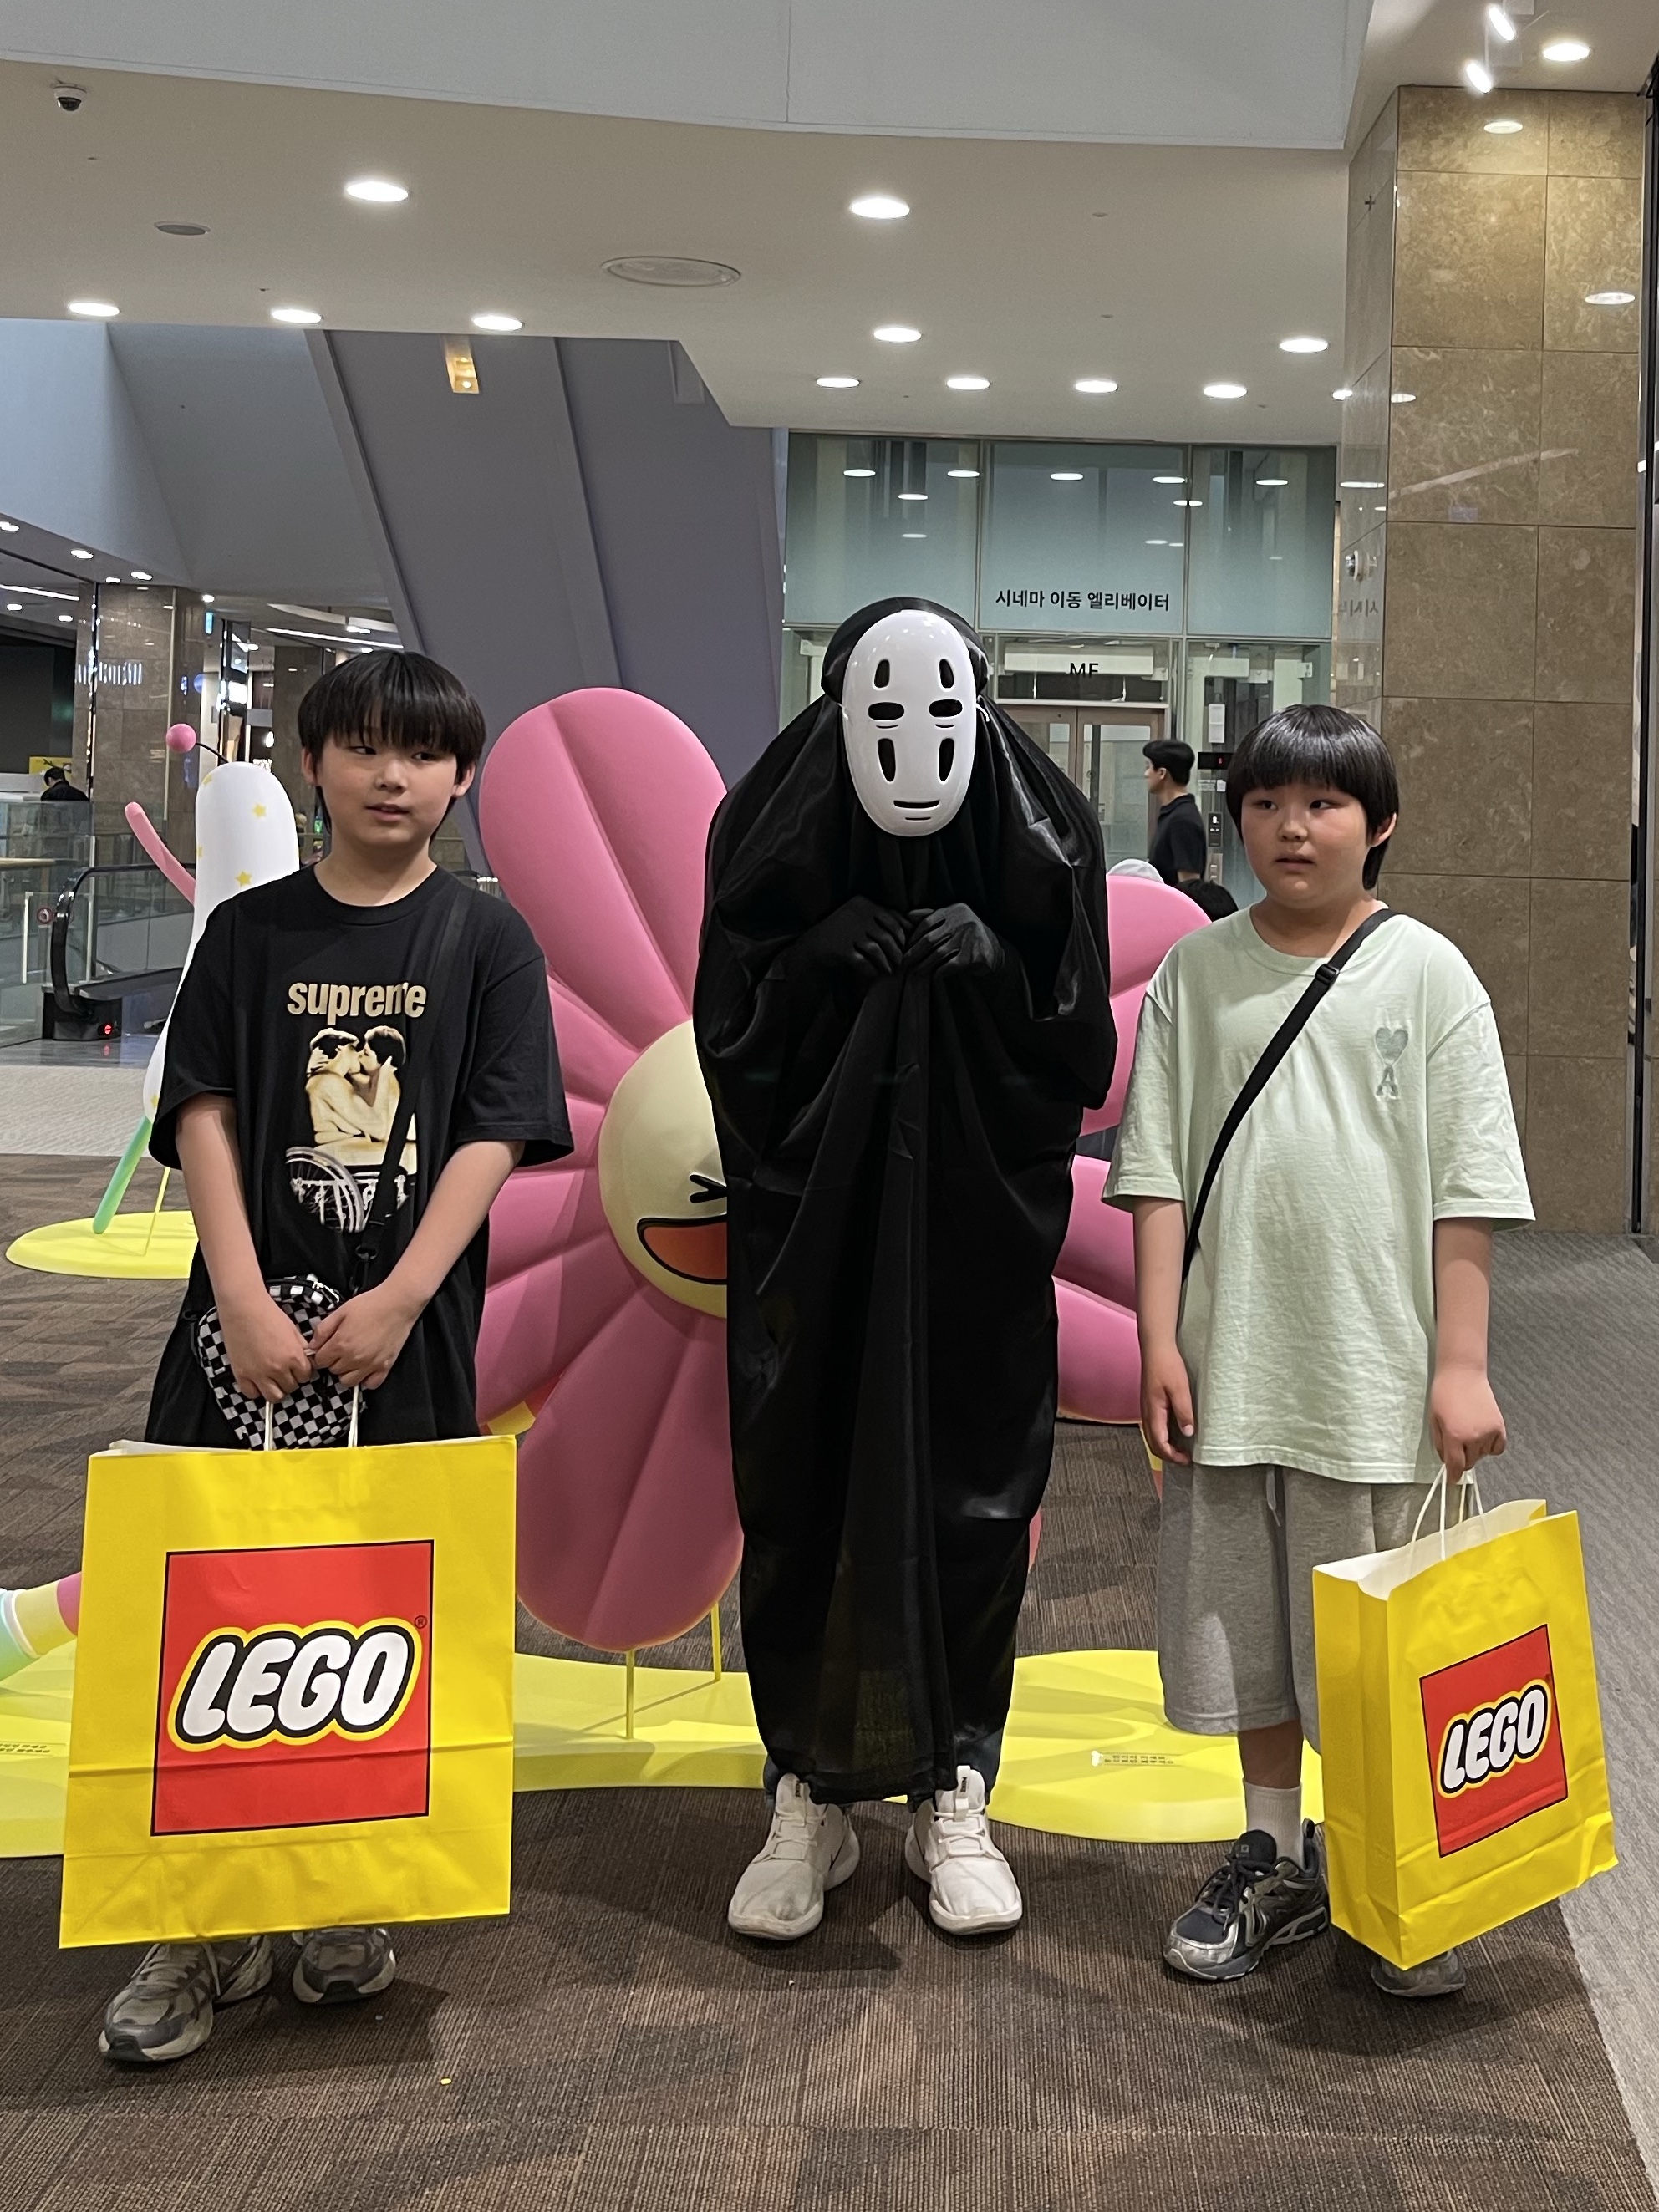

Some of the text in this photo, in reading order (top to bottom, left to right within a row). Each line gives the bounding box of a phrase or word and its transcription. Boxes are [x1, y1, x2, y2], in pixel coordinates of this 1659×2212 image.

[995, 590, 1169, 611] 시네마 이동 엘리베이터
[178, 1628, 411, 1740] LEGO
[1442, 1686, 1546, 1792] LEGO
